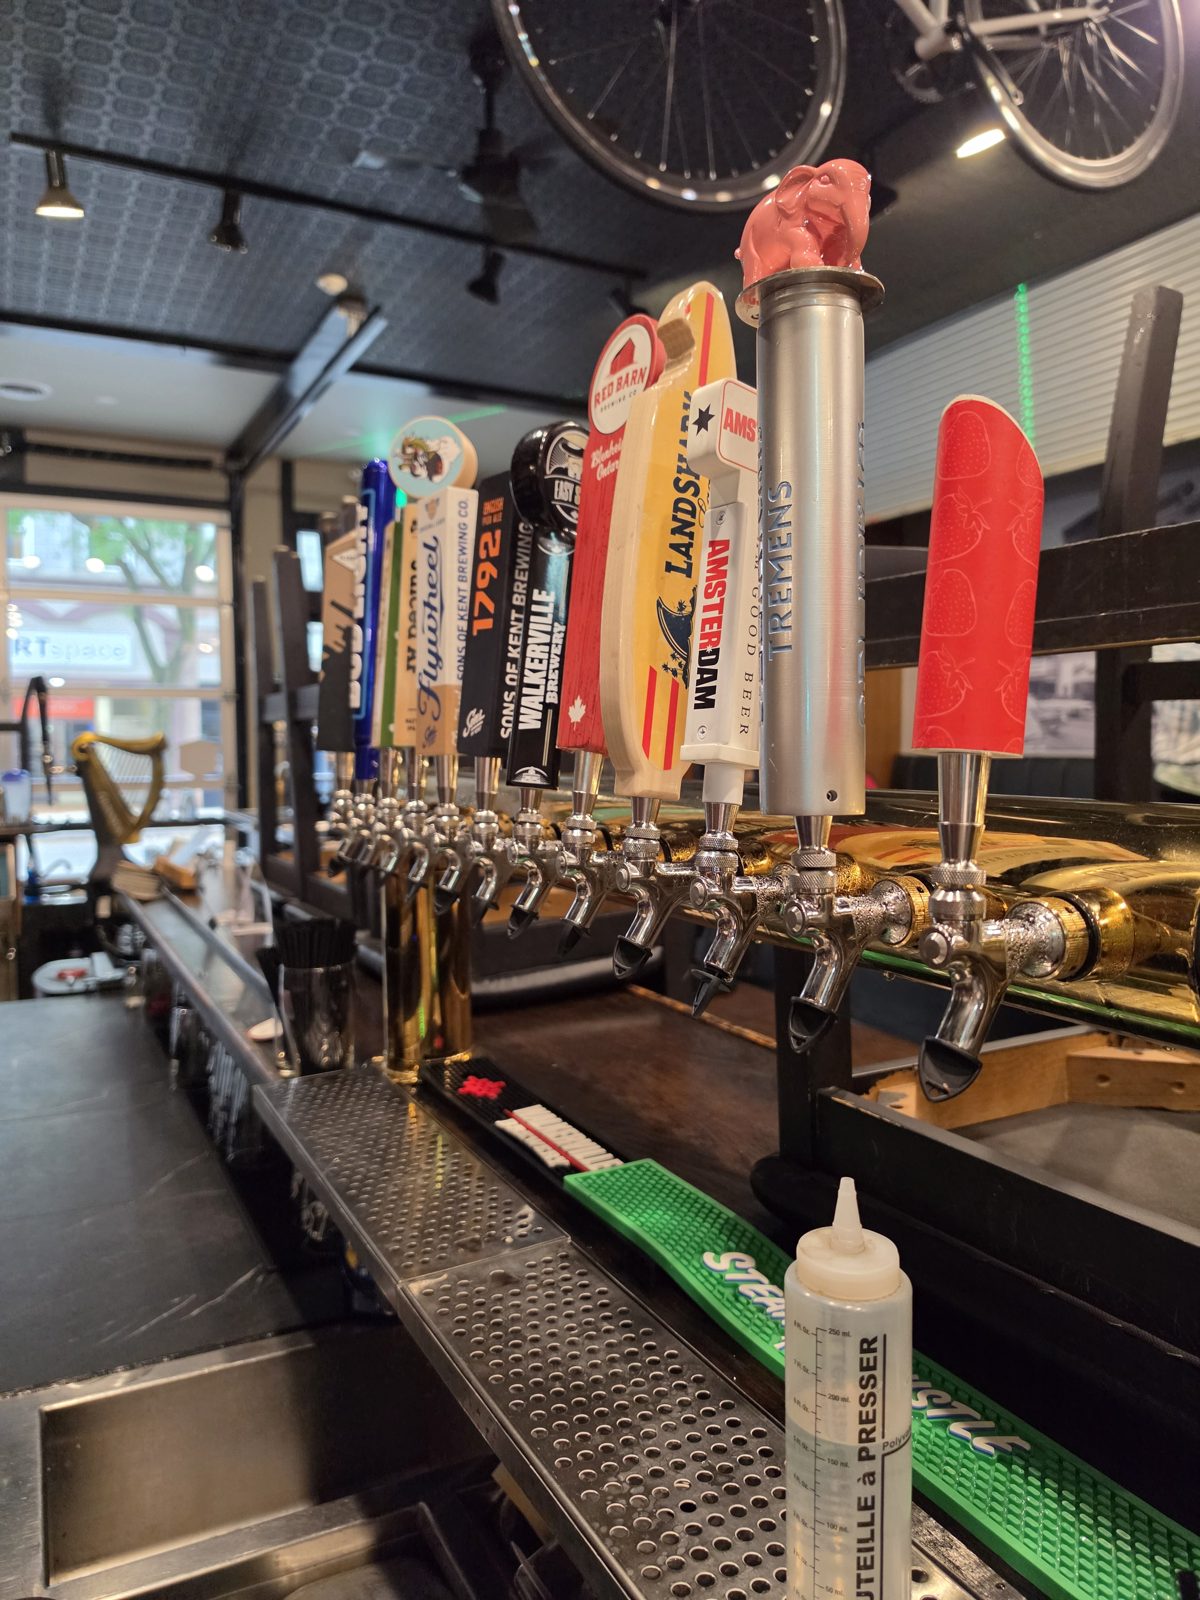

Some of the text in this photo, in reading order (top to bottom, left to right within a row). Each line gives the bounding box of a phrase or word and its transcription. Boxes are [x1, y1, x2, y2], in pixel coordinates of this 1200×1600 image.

[594, 366, 647, 409] RED BARN
[458, 522, 469, 583] BREWING
[458, 587, 468, 622] KENT
[473, 528, 502, 636] 1792
[768, 479, 793, 662] TREMENS
[500, 521, 533, 739] SONS OF KENT BREWING
[518, 588, 556, 730] WALKERVILLE
[546, 622, 566, 705] BREWERY
[693, 538, 731, 710] AMSTERDAM
[739, 586, 760, 735] GOOD BEER
[828, 1328, 840, 1336] 250
[858, 1335, 878, 1461] PRESSER
[857, 1471, 876, 1486] à
